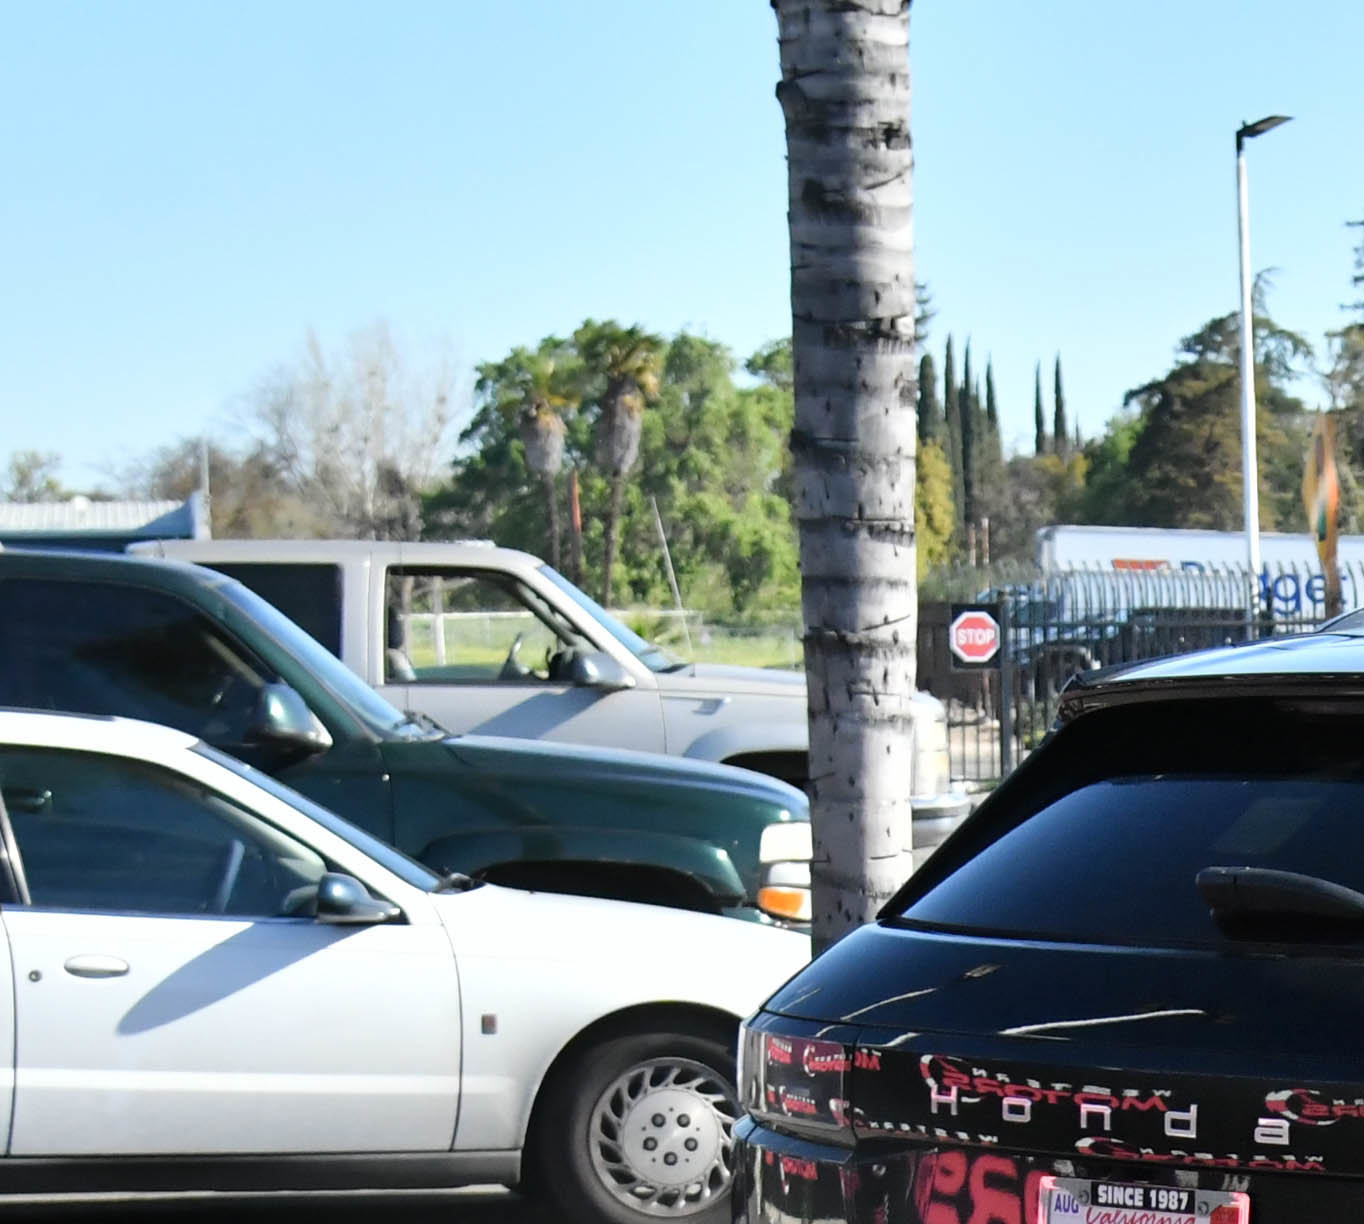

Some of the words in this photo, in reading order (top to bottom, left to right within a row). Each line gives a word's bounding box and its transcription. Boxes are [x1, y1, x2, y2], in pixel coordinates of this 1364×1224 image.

[957, 628, 995, 645] STOP
[1054, 1193, 1079, 1214] AUG
[1097, 1184, 1145, 1207] SINCE
[1150, 1189, 1189, 1211] 1987
